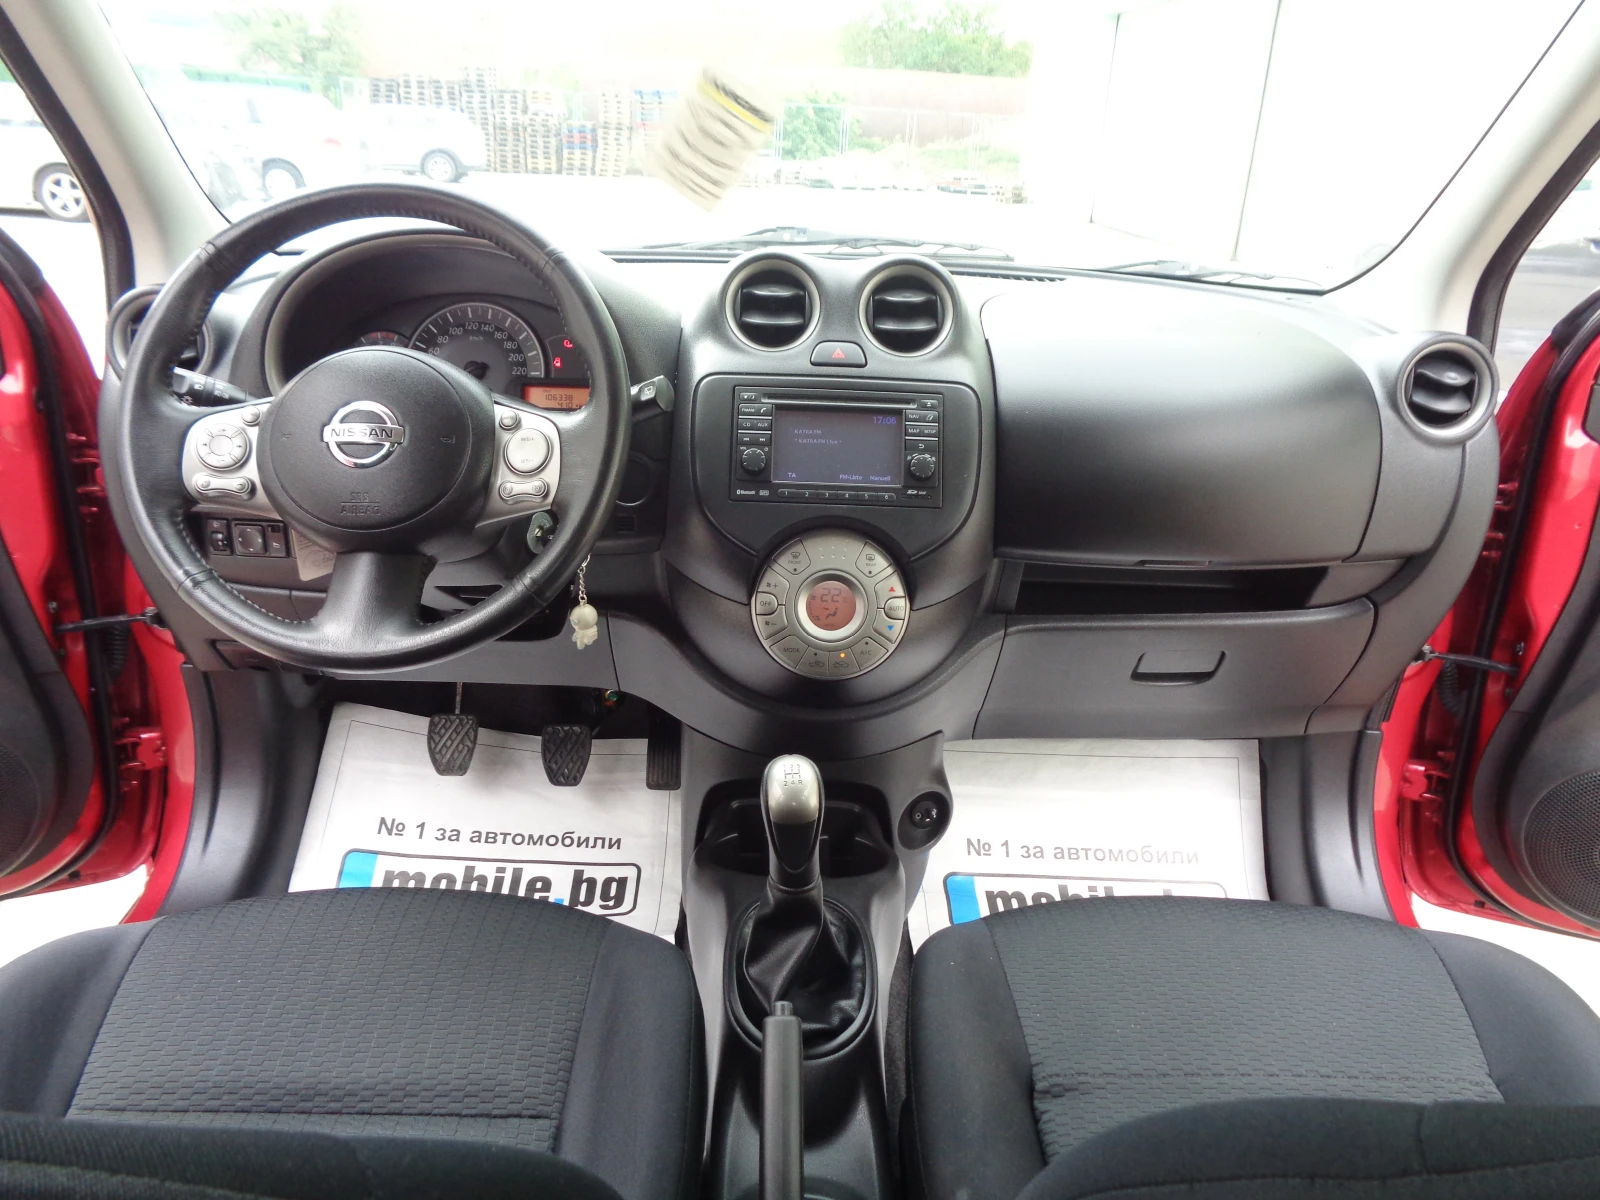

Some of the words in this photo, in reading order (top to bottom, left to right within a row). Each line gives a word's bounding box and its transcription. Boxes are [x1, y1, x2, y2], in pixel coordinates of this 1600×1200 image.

[465, 322, 479, 330] 120
[481, 324, 495, 332] 140
[449, 327, 463, 335] 100
[494, 331, 508, 339] 160
[437, 335, 449, 343] 80
[503, 341, 518, 349] 180
[428, 347, 440, 355] 60
[508, 353, 524, 361] 200
[512, 366, 527, 375] 220
[545, 393, 574, 402] 106338
[873, 416, 897, 425] 17:06
[330, 428, 393, 439] NISSAN
[350, 492, 369, 501] SRS
[340, 504, 381, 515] AIRBAG
[821, 587, 842, 603] 22
[888, 604, 905, 612] AUTO
[415, 821, 426, 840] 1
[434, 827, 461, 842] за
[469, 828, 623, 850] автомобили
[1000, 839, 1011, 858] 1
[1020, 845, 1045, 860] за
[1053, 845, 1199, 865] автомобили
